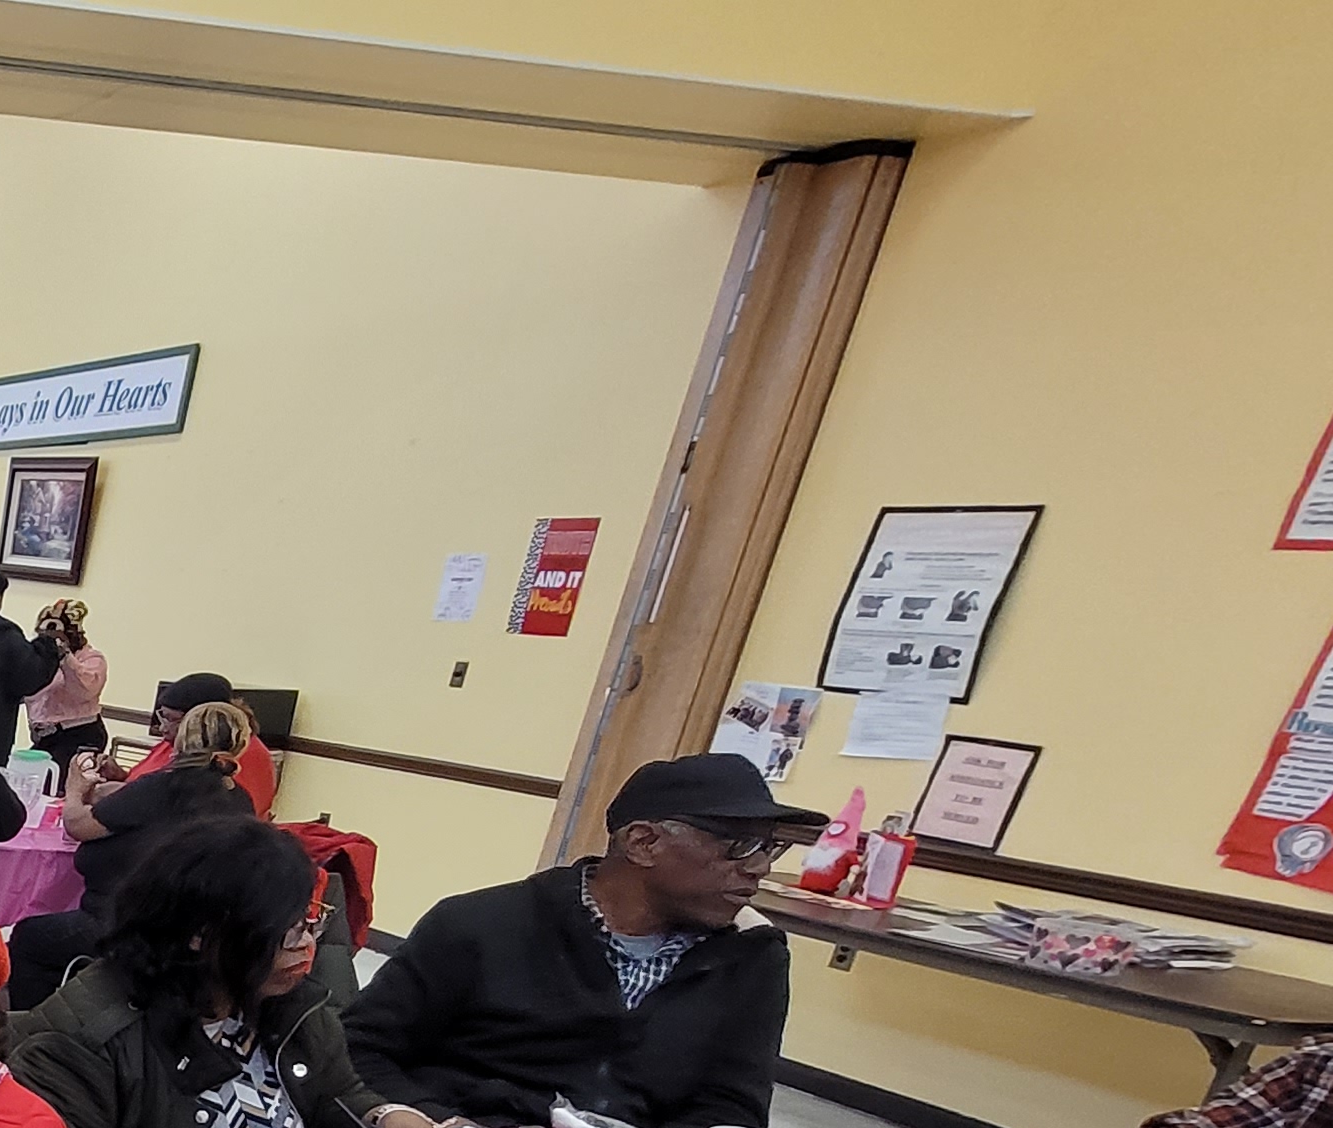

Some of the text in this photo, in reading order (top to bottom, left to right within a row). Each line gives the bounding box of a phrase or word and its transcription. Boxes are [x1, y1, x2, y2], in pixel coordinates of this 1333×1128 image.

[29, 389, 50, 424] in
[54, 385, 96, 422] Our
[95, 377, 173, 417] Hearts
[534, 570, 584, 588] AND IT
